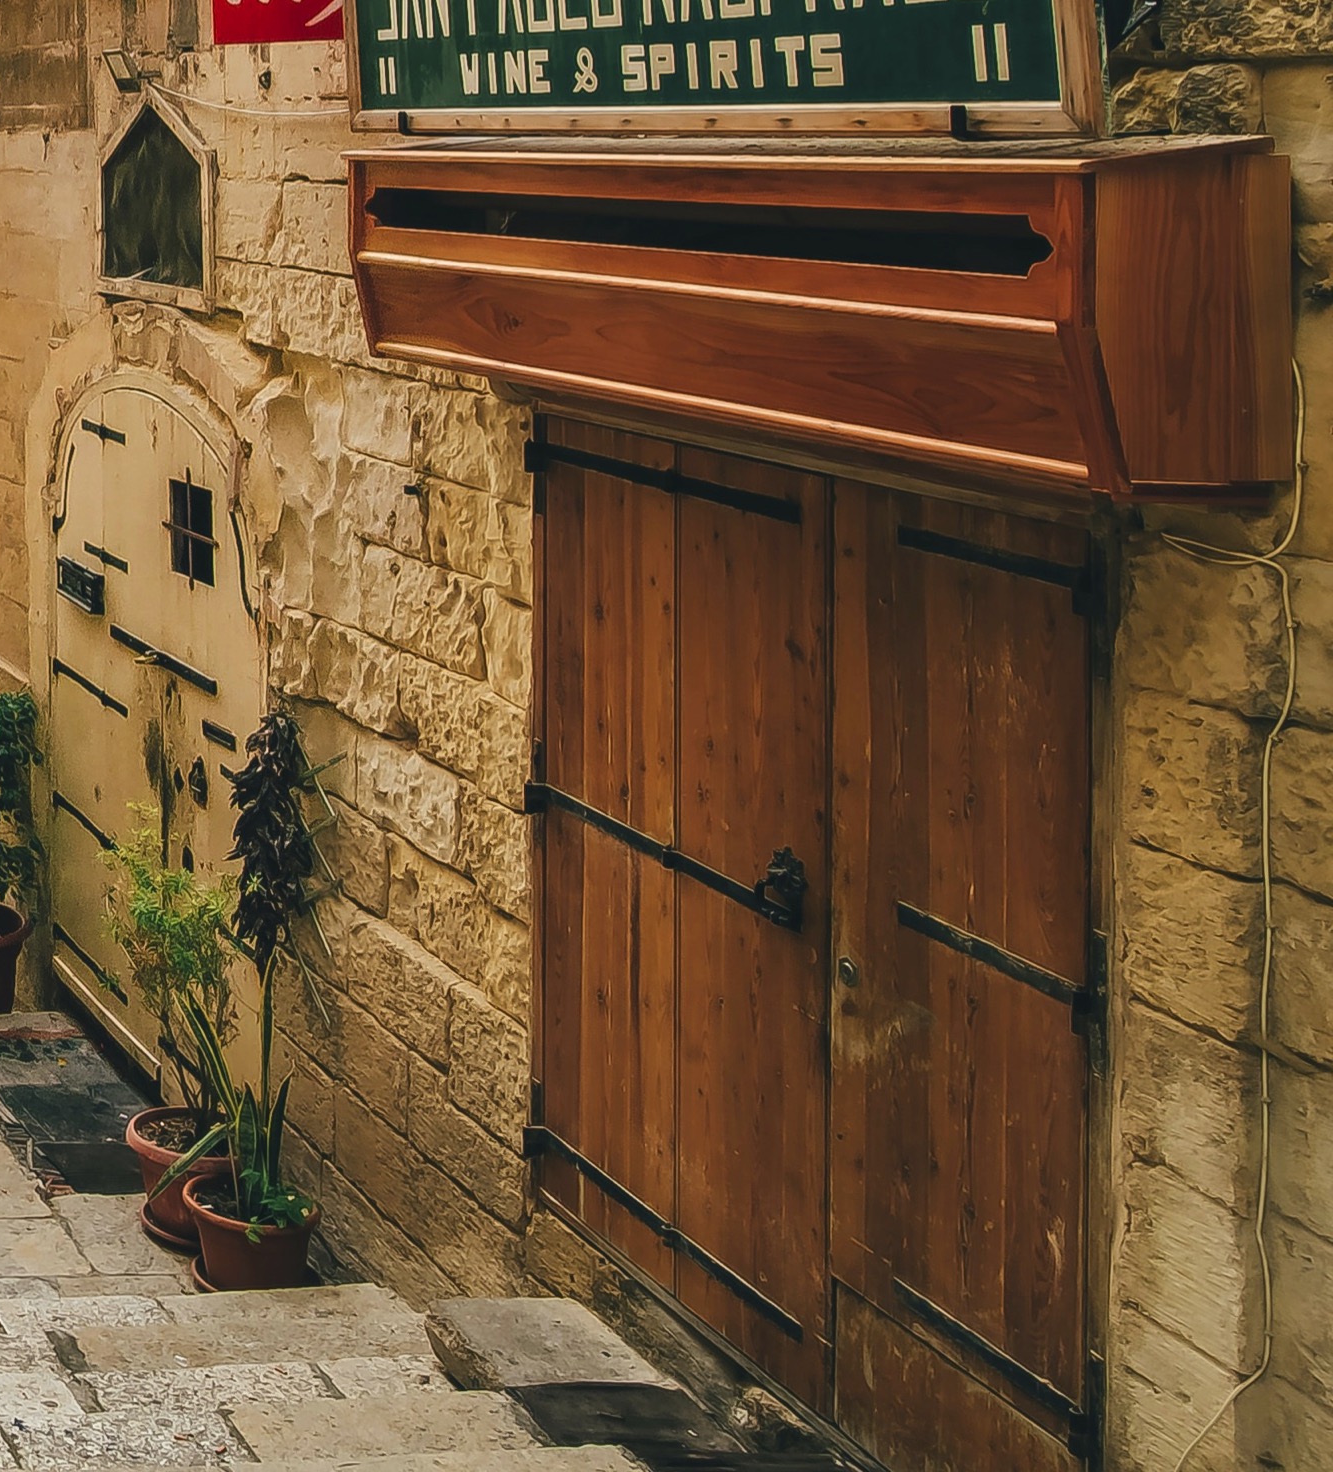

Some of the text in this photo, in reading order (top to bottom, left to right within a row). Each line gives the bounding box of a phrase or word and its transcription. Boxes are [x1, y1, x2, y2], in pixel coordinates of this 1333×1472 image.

[459, 48, 552, 96] WINE
[572, 47, 599, 94] &
[620, 32, 845, 92] SPIRITS
